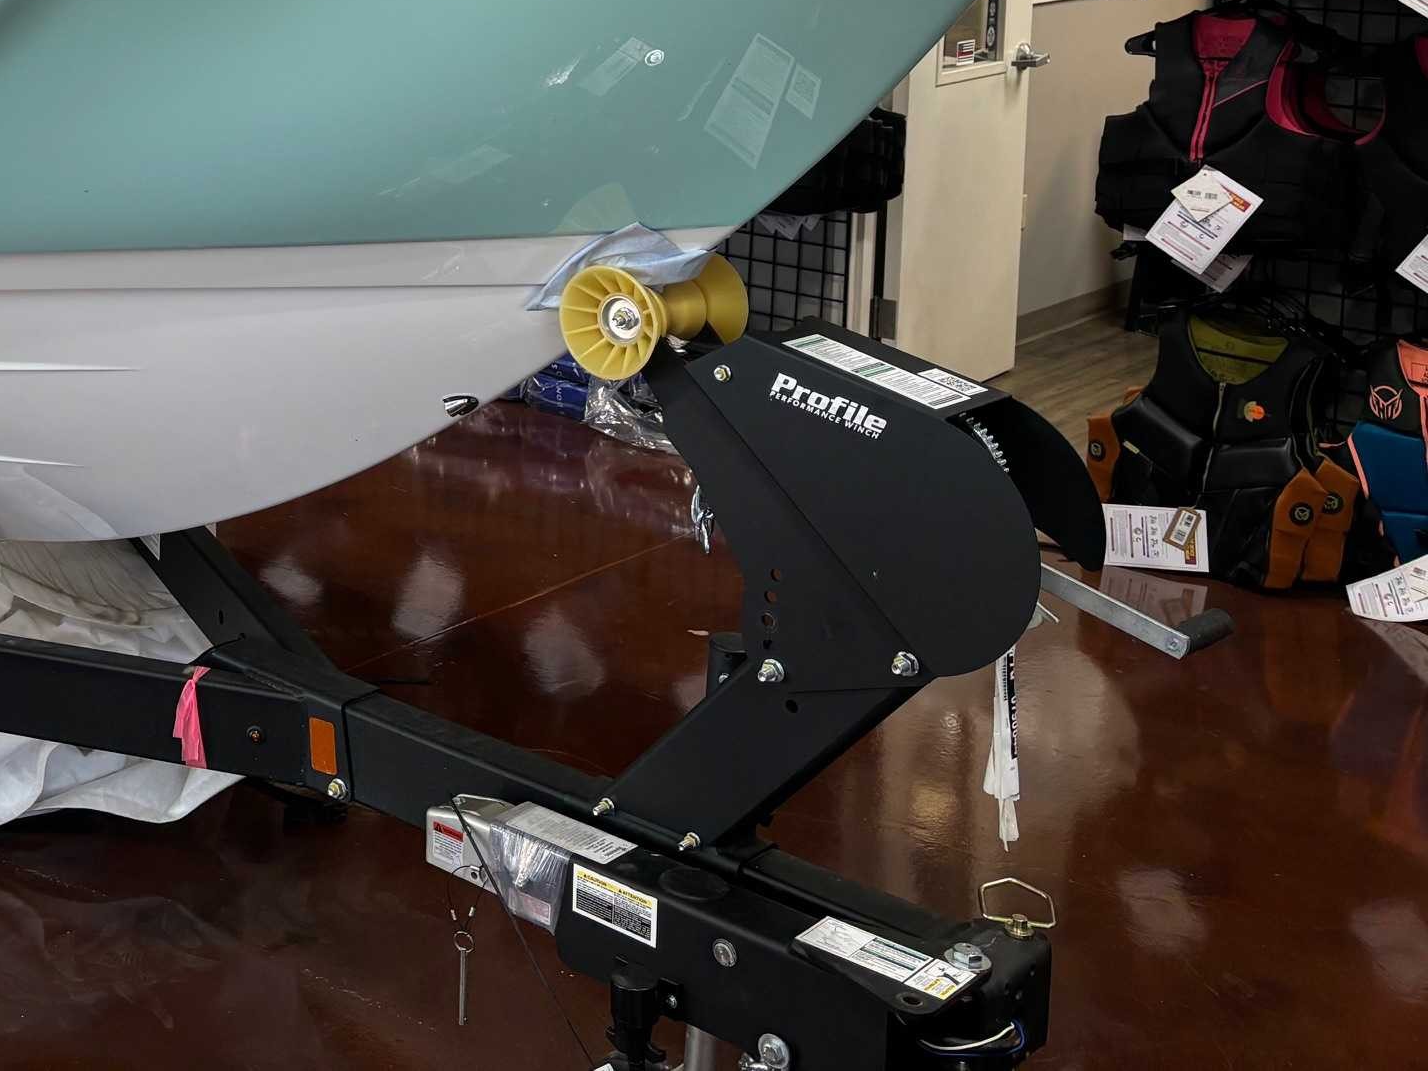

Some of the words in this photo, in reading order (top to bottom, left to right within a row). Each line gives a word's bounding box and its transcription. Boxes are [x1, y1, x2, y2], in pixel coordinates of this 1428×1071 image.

[769, 390, 842, 424] PERFORMANCE
[844, 420, 880, 440] WINCH
[771, 372, 887, 434] Profile
